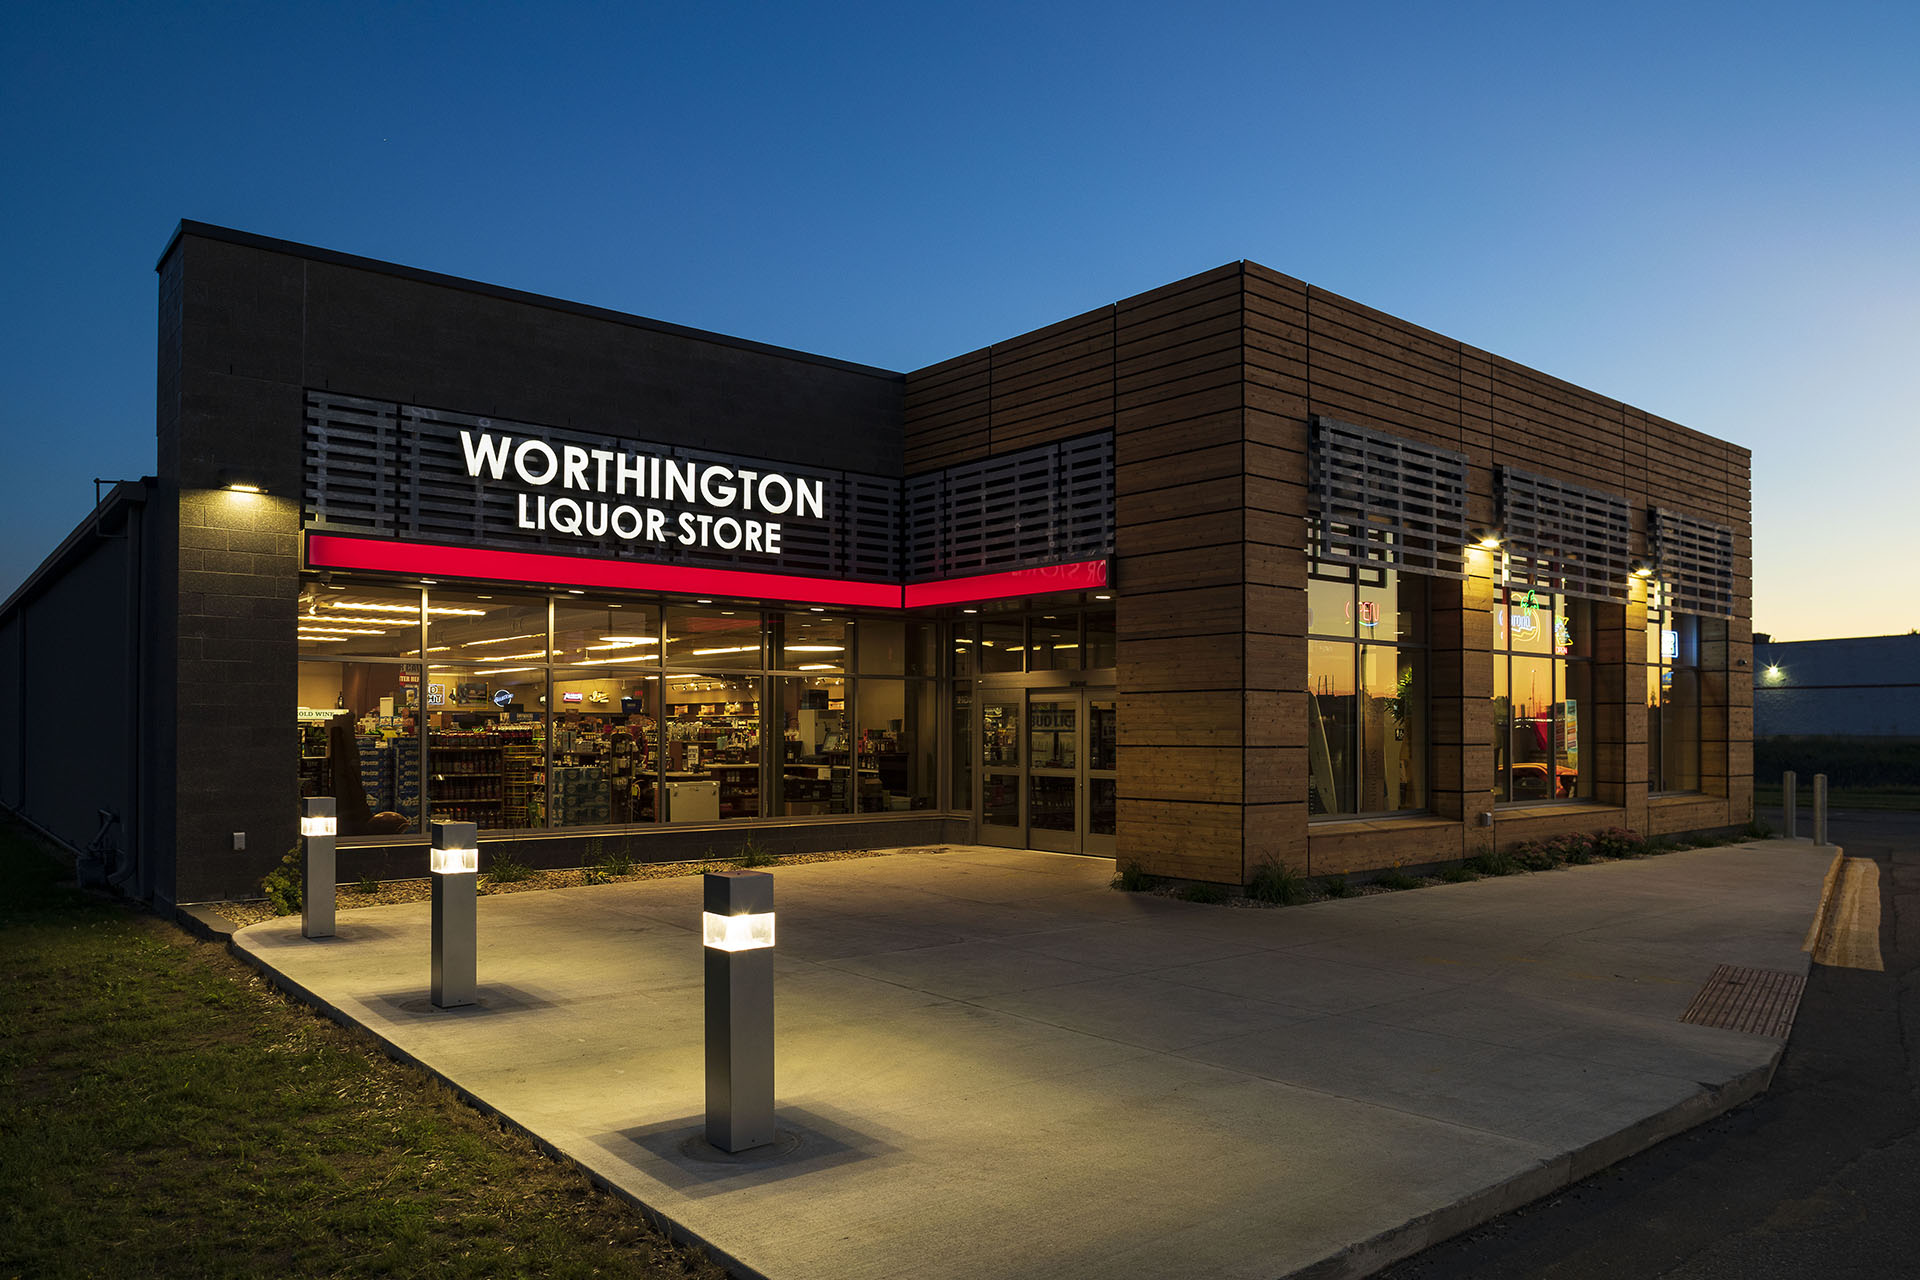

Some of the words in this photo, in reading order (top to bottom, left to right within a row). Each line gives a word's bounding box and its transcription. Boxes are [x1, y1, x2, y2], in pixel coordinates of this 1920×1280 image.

[459, 430, 824, 519] WORTHINGTON
[517, 493, 666, 542] LIQUOR
[677, 511, 782, 554] STORE
